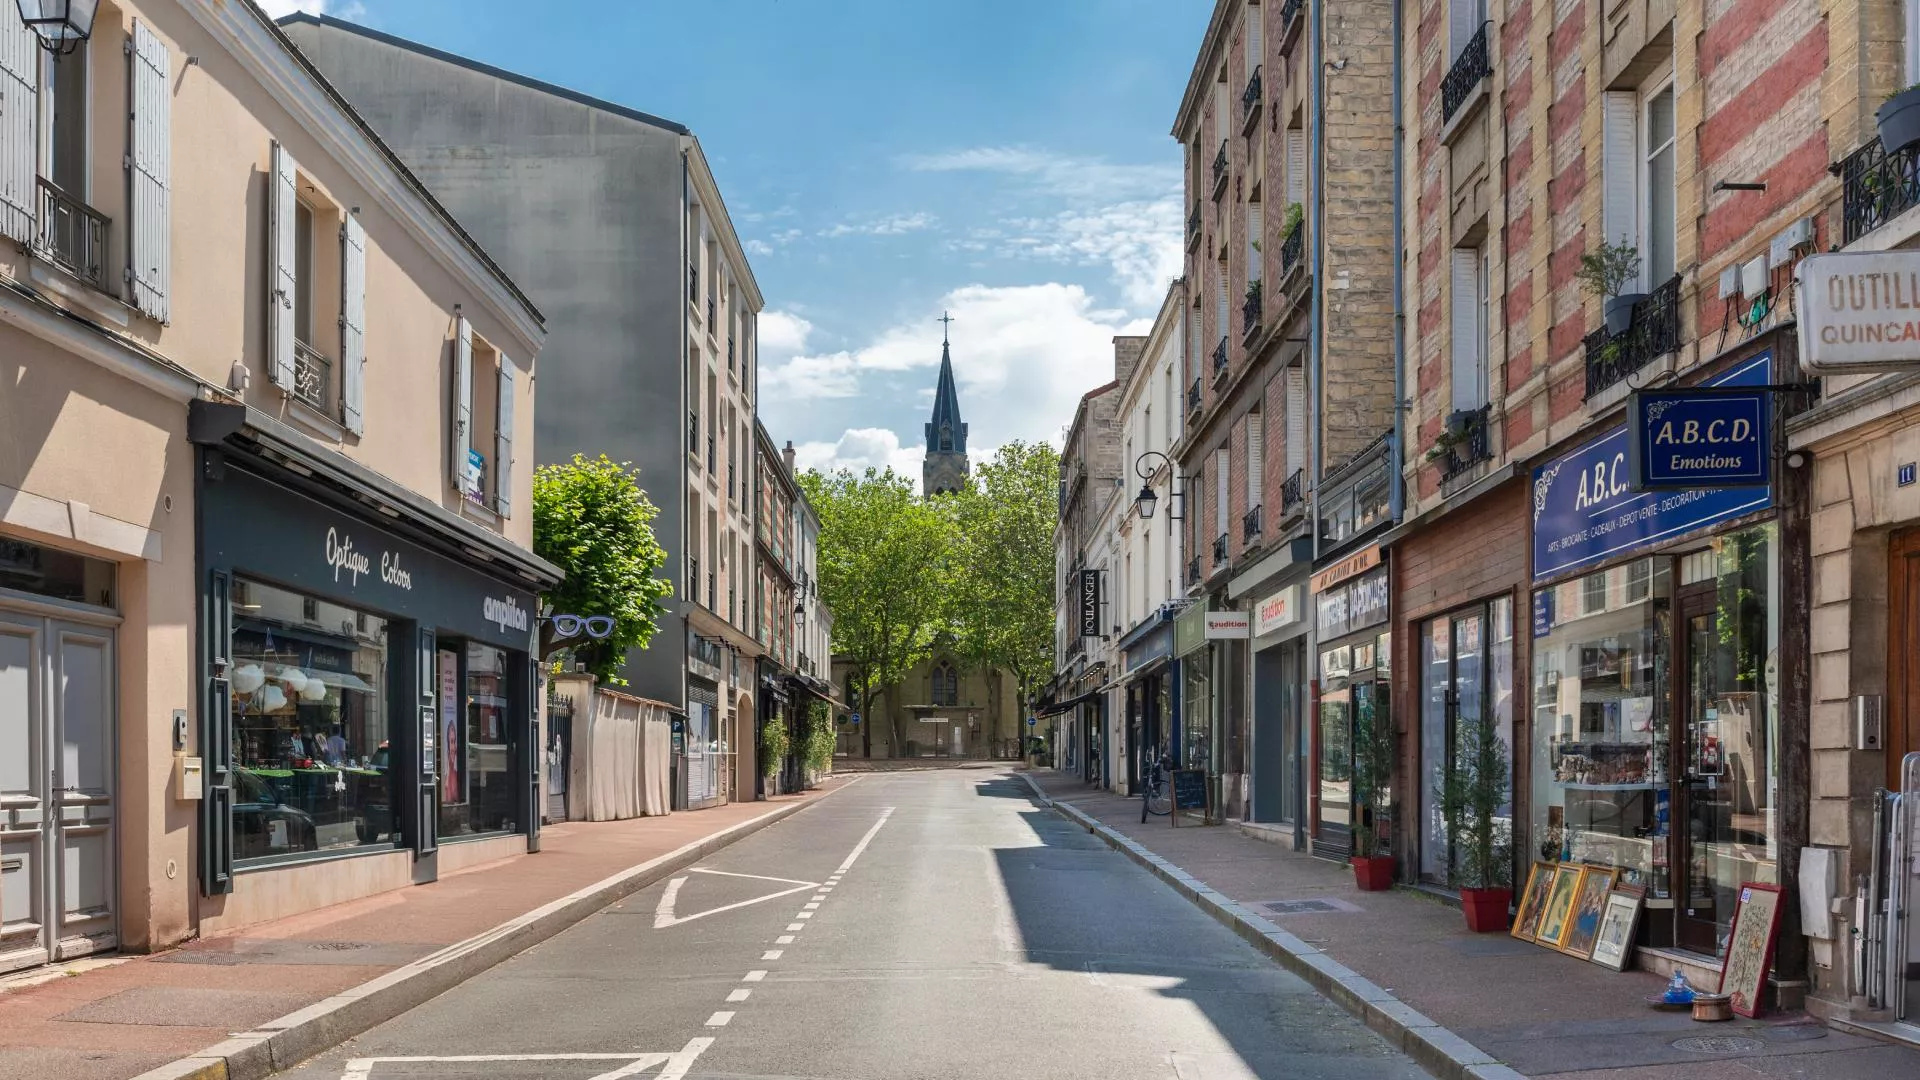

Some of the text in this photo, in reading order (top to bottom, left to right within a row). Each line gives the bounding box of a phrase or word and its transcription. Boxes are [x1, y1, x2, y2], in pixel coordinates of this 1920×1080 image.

[1655, 418, 1756, 445] A.B.C.D.
[1670, 453, 1742, 470] Emotions
[1901, 466, 1911, 483] 11
[1575, 452, 1630, 512] A.B.C.
[1561, 529, 1588, 549] BROCANTE
[1590, 520, 1616, 538] CADEAUX
[1619, 510, 1638, 528] DEPOT
[1639, 503, 1657, 520] VENTE
[1661, 489, 1706, 512] DECORATION
[326, 526, 370, 588] Optique
[483, 595, 528, 633] amplifon
[1085, 573, 1095, 635] BOULANGER
[674, 721, 681, 731] P
